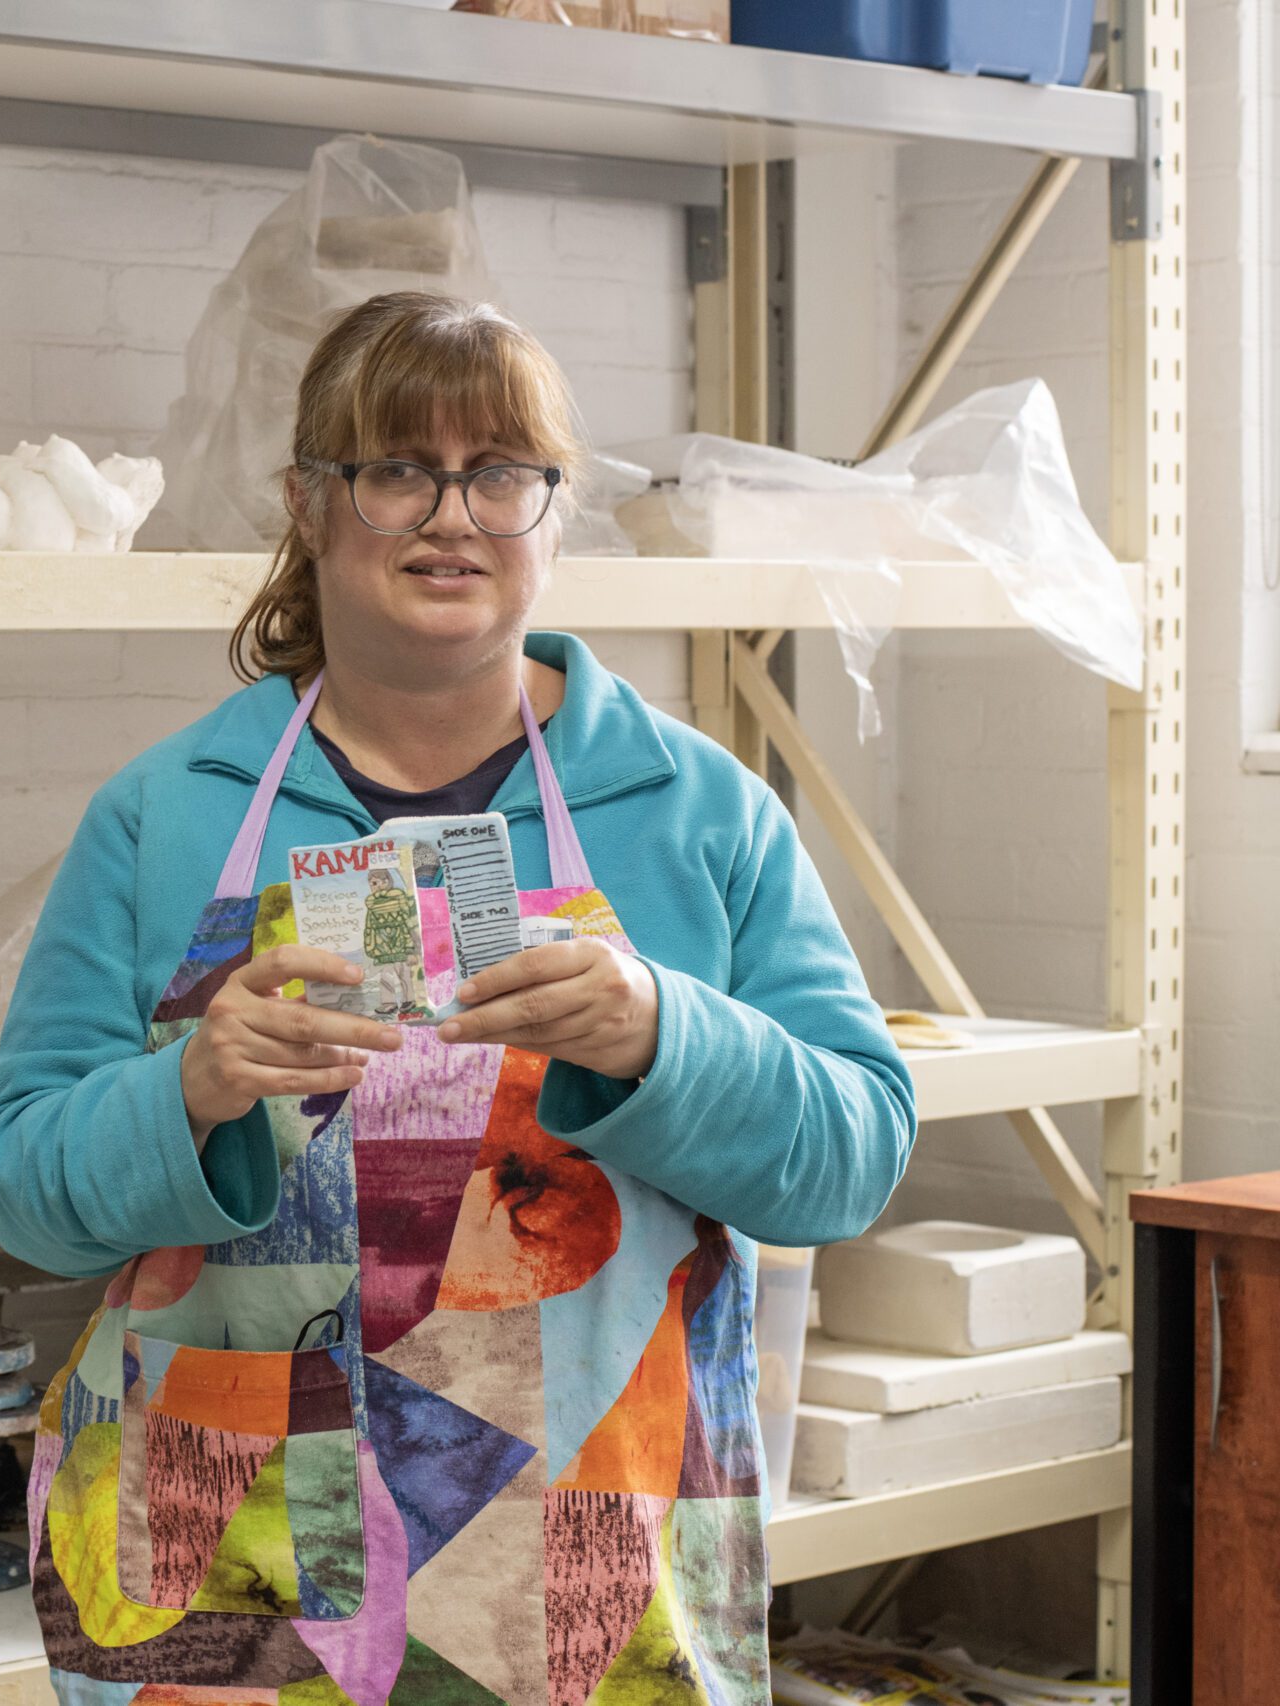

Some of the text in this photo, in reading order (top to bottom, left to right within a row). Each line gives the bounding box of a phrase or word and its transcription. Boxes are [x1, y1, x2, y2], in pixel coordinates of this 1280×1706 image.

[442, 824, 496, 839] SIDE ONE
[460, 907, 509, 921] SIDE TWO
